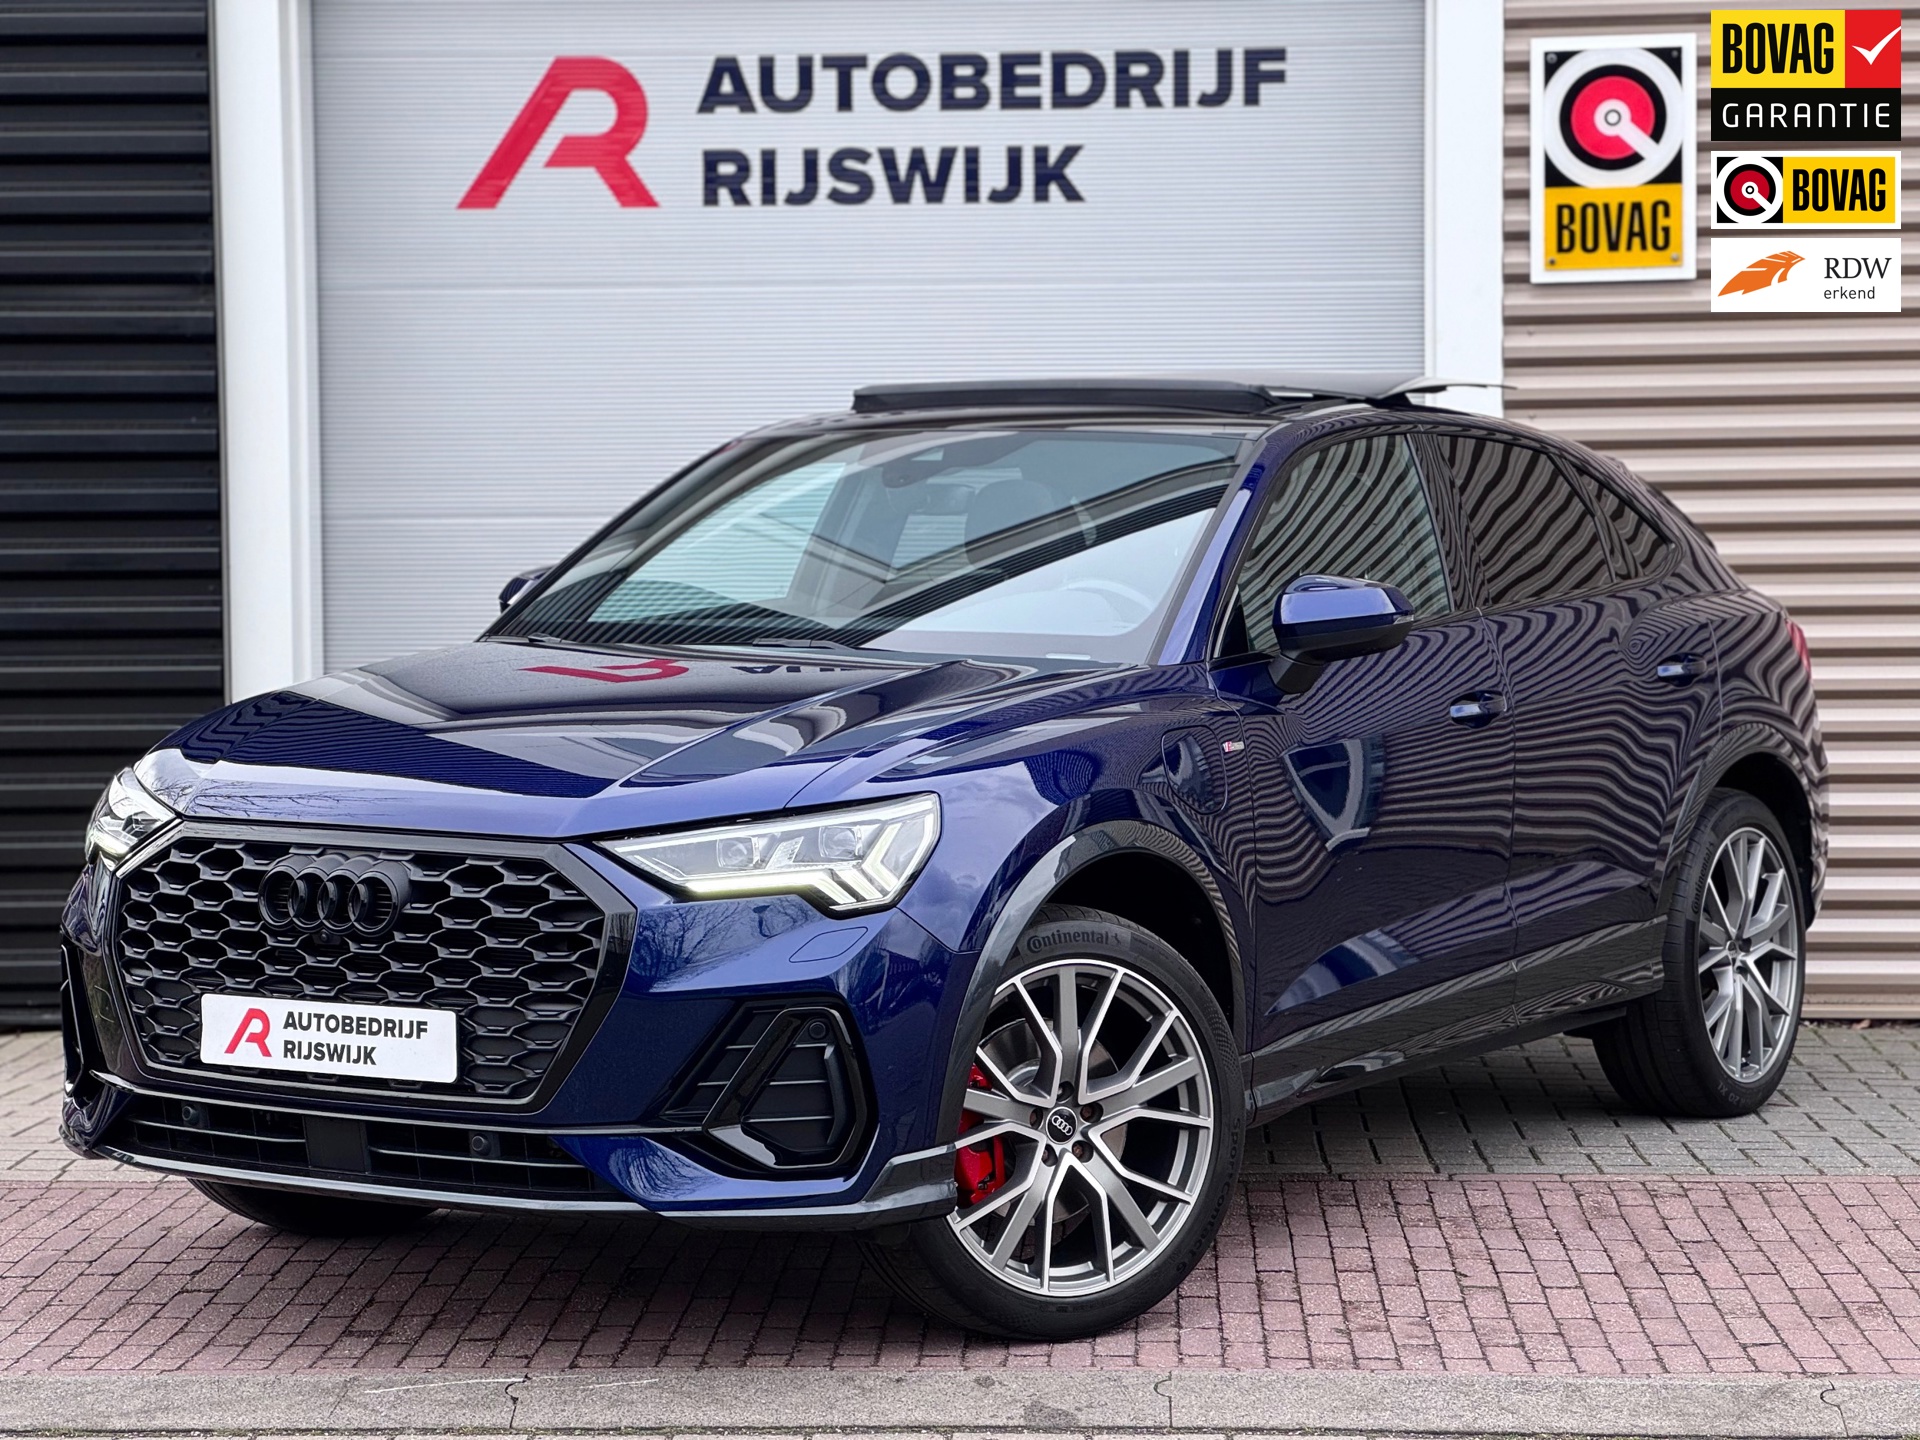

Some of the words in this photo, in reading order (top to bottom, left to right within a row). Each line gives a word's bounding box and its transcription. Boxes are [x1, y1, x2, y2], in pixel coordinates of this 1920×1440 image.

[697, 47, 1288, 115] AUTOBEDRIJF
[702, 145, 1086, 208] RIJSWIJK
[1556, 200, 1672, 255] BOVAG
[1691, 846, 1713, 915] Continental
[1026, 929, 1110, 953] Continental
[282, 1010, 428, 1040] AUTOBEDRIJF
[282, 1040, 377, 1066] RIJSWIJK
